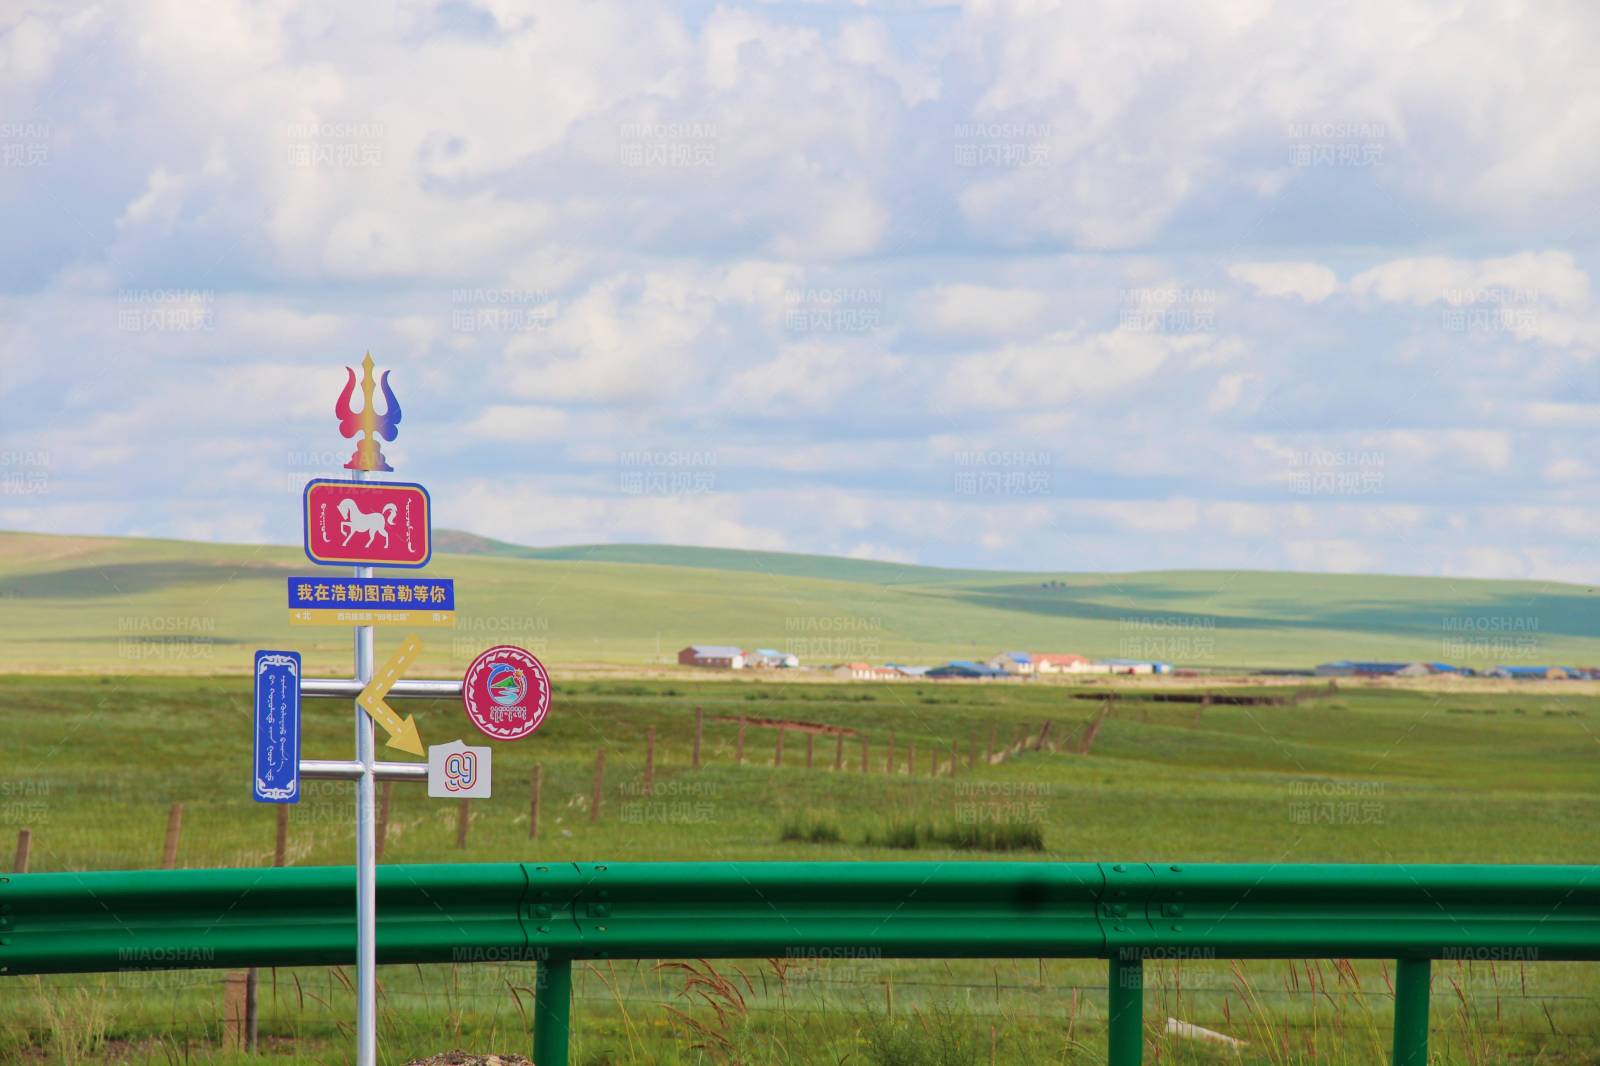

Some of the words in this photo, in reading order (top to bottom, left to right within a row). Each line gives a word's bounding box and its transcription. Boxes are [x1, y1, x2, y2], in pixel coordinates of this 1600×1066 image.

[297, 584, 446, 602] 我在浩勒图高勒等你
